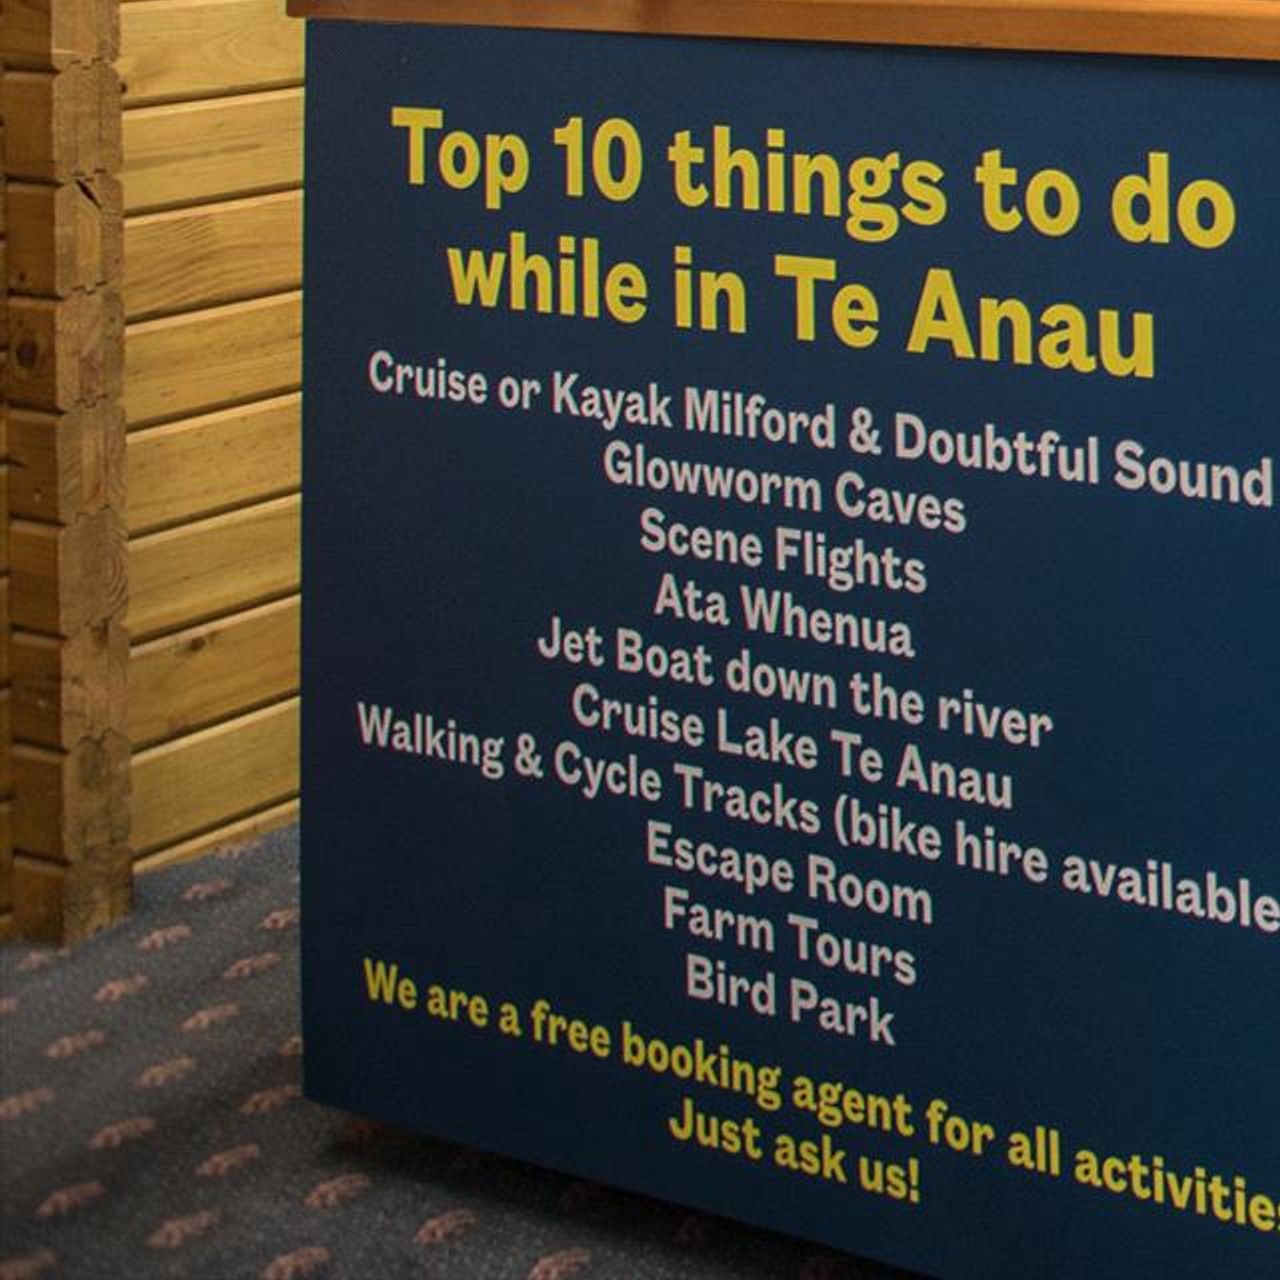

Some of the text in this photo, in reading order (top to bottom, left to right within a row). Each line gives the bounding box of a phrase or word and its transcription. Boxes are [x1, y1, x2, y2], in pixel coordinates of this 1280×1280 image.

[391, 106, 1236, 249] Top 10 things to do
[446, 231, 1154, 379] while in Te Anau
[368, 350, 1273, 507] Cruise or Kayak Milford & Doubtful Sound
[603, 440, 966, 534] Glowworm Caves
[640, 507, 927, 594] Scene Flights
[654, 573, 915, 658] Ata Whenua
[537, 616, 1053, 747] Jet Boat down the river
[357, 702, 504, 779] Walking
[514, 733, 543, 778] &
[554, 741, 661, 801] Cycle
[673, 763, 820, 834] Tracks
[834, 794, 941, 860] (bike
[956, 820, 1048, 883] hire
[572, 683, 1012, 809] Cruise Lake Te Anau
[647, 820, 932, 924] Escape Room
[664, 886, 916, 985] Farm Tours
[687, 953, 895, 1045] Bird Park
[364, 959, 416, 1009] We
[428, 986, 488, 1026] are
[499, 1004, 521, 1035] a
[531, 1000, 610, 1057] free
[622, 1022, 781, 1110] booking
[793, 1076, 914, 1136] agent
[926, 1099, 995, 1154] for
[1008, 1126, 1060, 1175] all
[669, 1098, 921, 1205] Just ask us!
